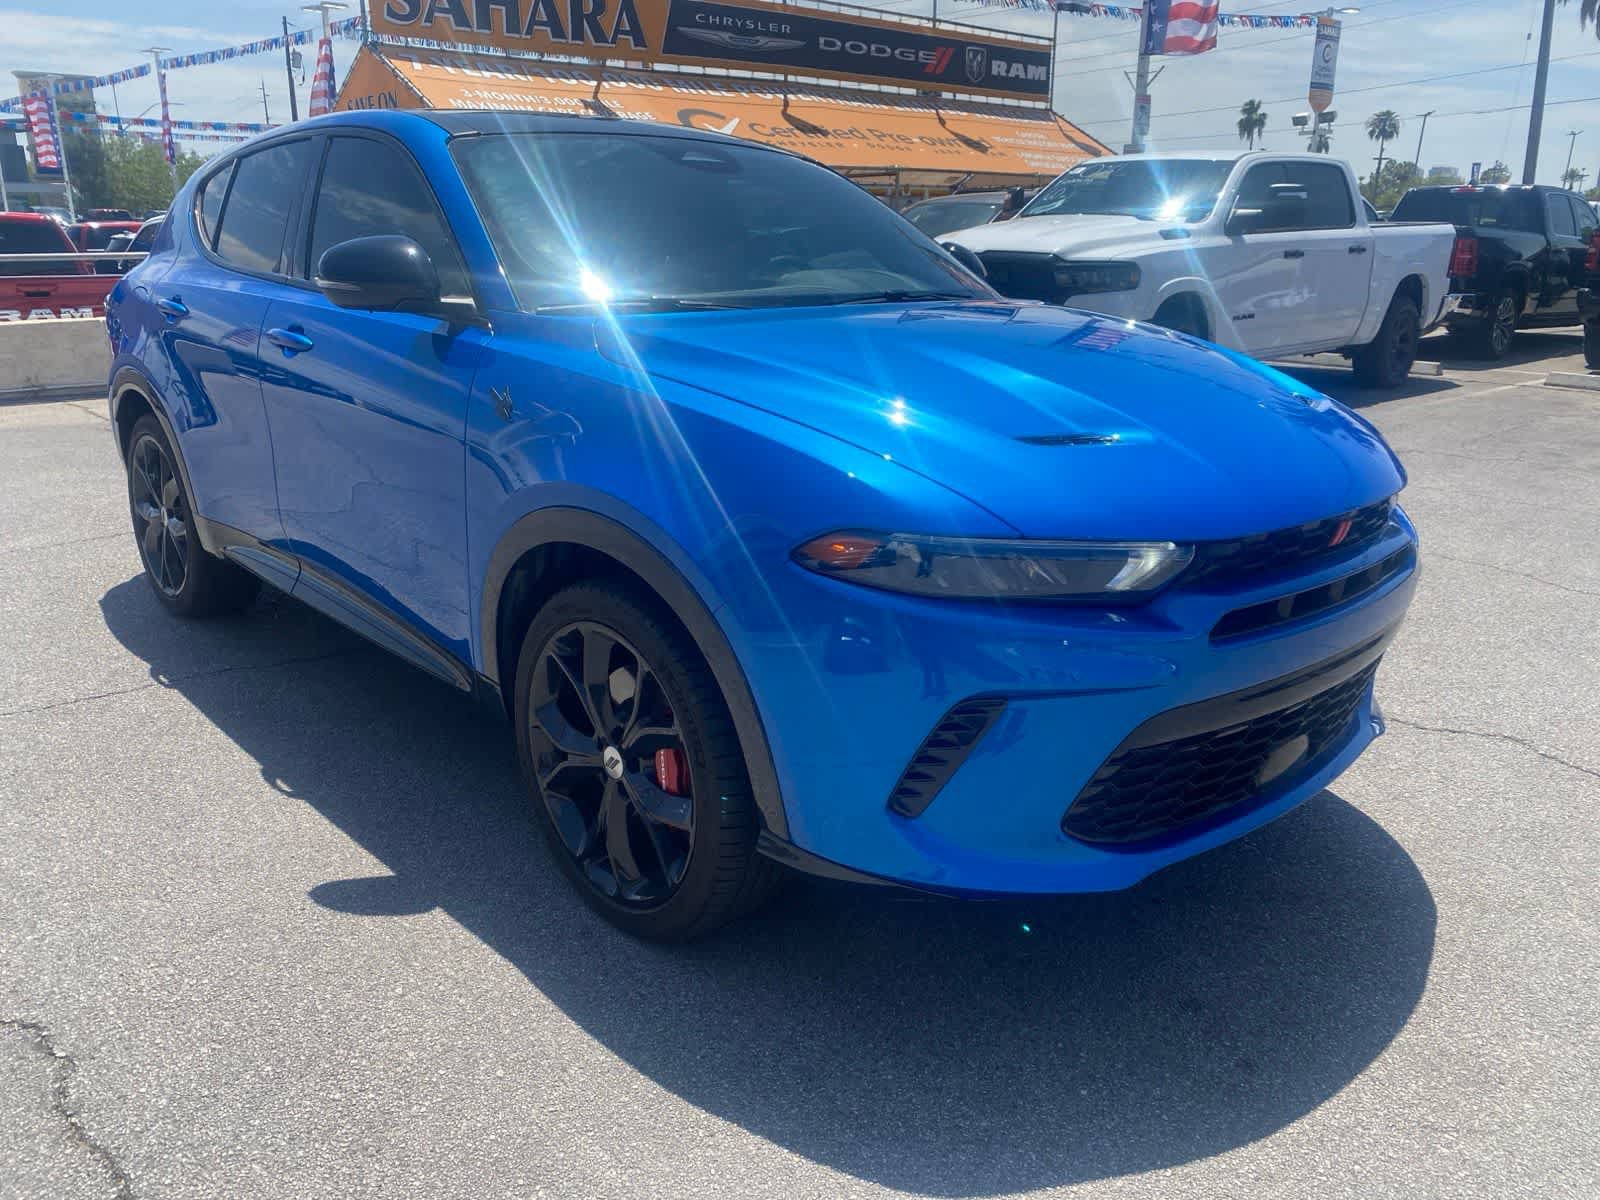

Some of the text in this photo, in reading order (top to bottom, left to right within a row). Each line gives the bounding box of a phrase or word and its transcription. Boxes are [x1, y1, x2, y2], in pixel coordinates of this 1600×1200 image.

[384, 0, 649, 49] SAHARA
[695, 13, 792, 34] CHRYSLER
[818, 36, 938, 64] DODGE
[991, 60, 1048, 80] RAM
[748, 122, 868, 141] Ceried
[865, 128, 993, 150] Pre-ownd
